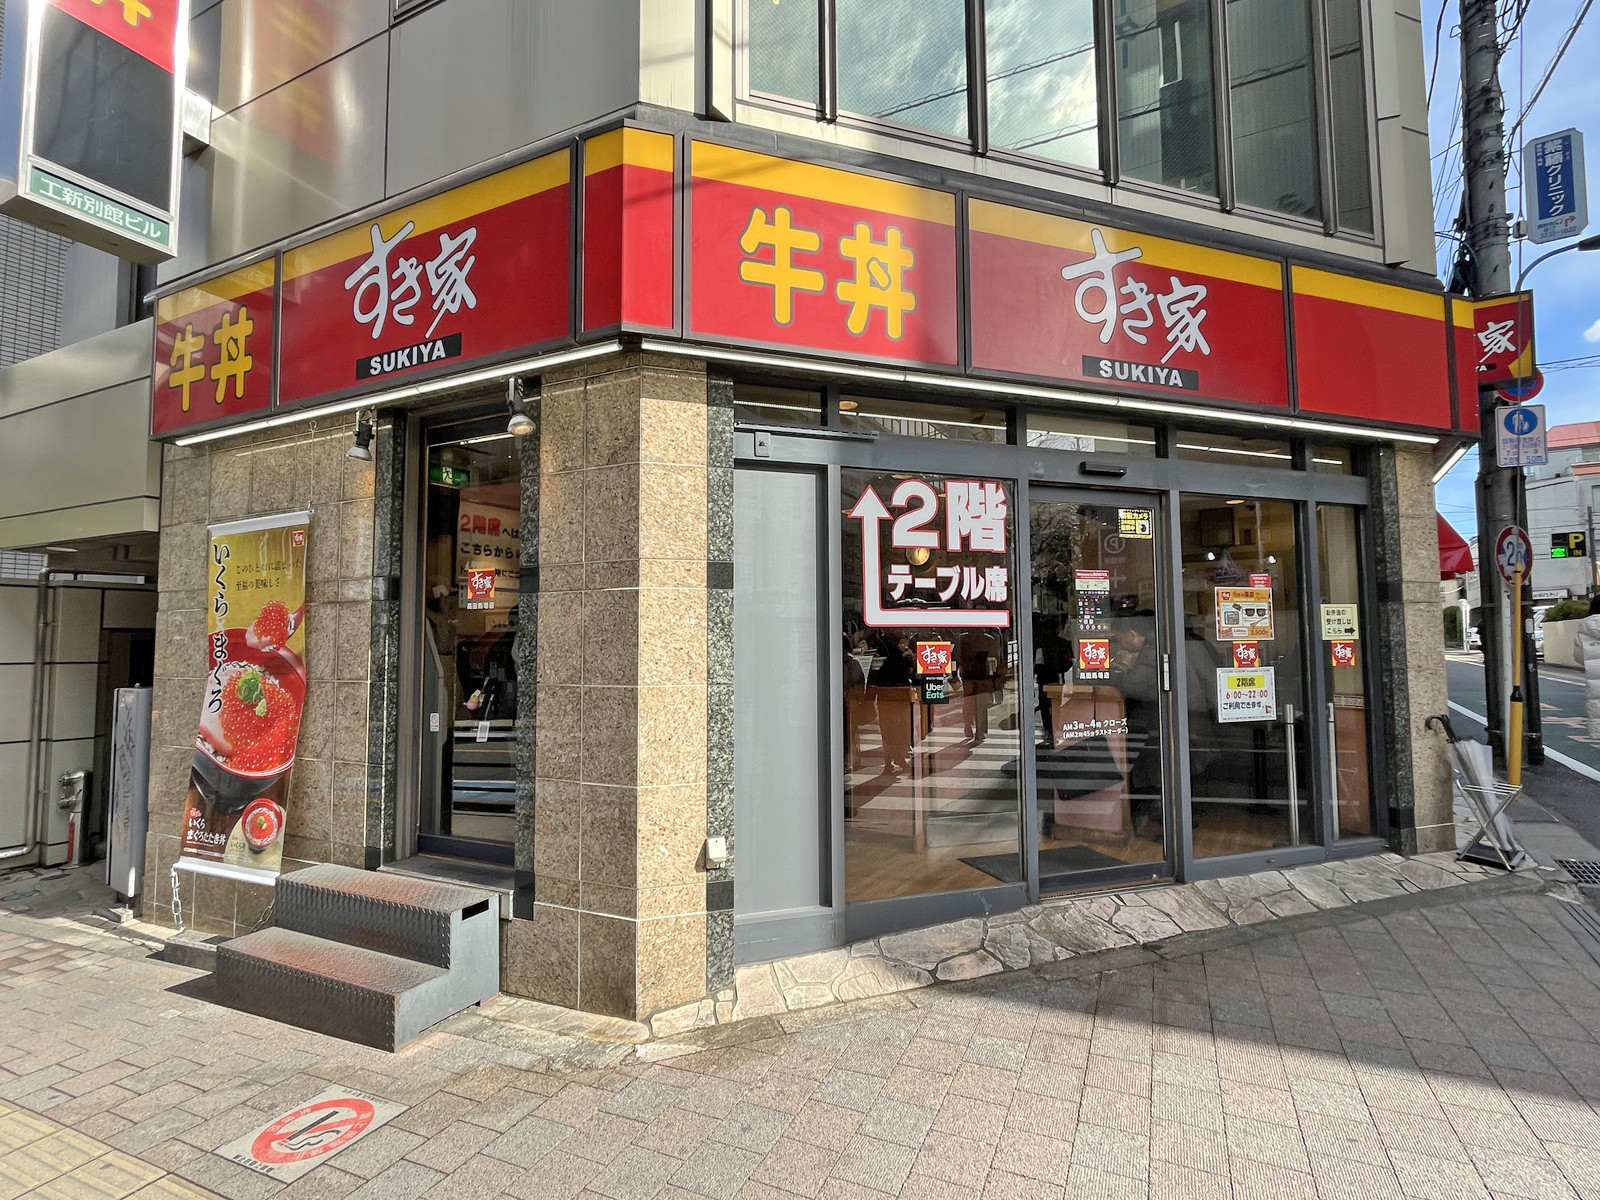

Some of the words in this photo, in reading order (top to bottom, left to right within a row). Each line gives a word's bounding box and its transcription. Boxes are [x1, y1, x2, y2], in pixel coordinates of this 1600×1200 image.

[39, 177, 162, 239] 工新別館ビル
[344, 220, 478, 340] すき家
[738, 203, 917, 342] 牛丼
[1061, 227, 1212, 364] すき家
[168, 304, 255, 412] 牛丼
[369, 339, 447, 376] SUKIYA
[1099, 359, 1184, 387] SUKIYA
[890, 478, 1008, 553] 2階
[460, 542, 515, 560] こちらから
[1568, 533, 1585, 549] P
[471, 571, 493, 591] すき家
[888, 564, 1008, 602] テーブル席
[920, 645, 948, 666] すき家
[1083, 642, 1107, 662] すき家
[925, 682, 945, 691] Uber
[925, 691, 946, 699] Eats
[188, 817, 206, 830] いくら
[186, 829, 227, 846] まぐろたたき丼
